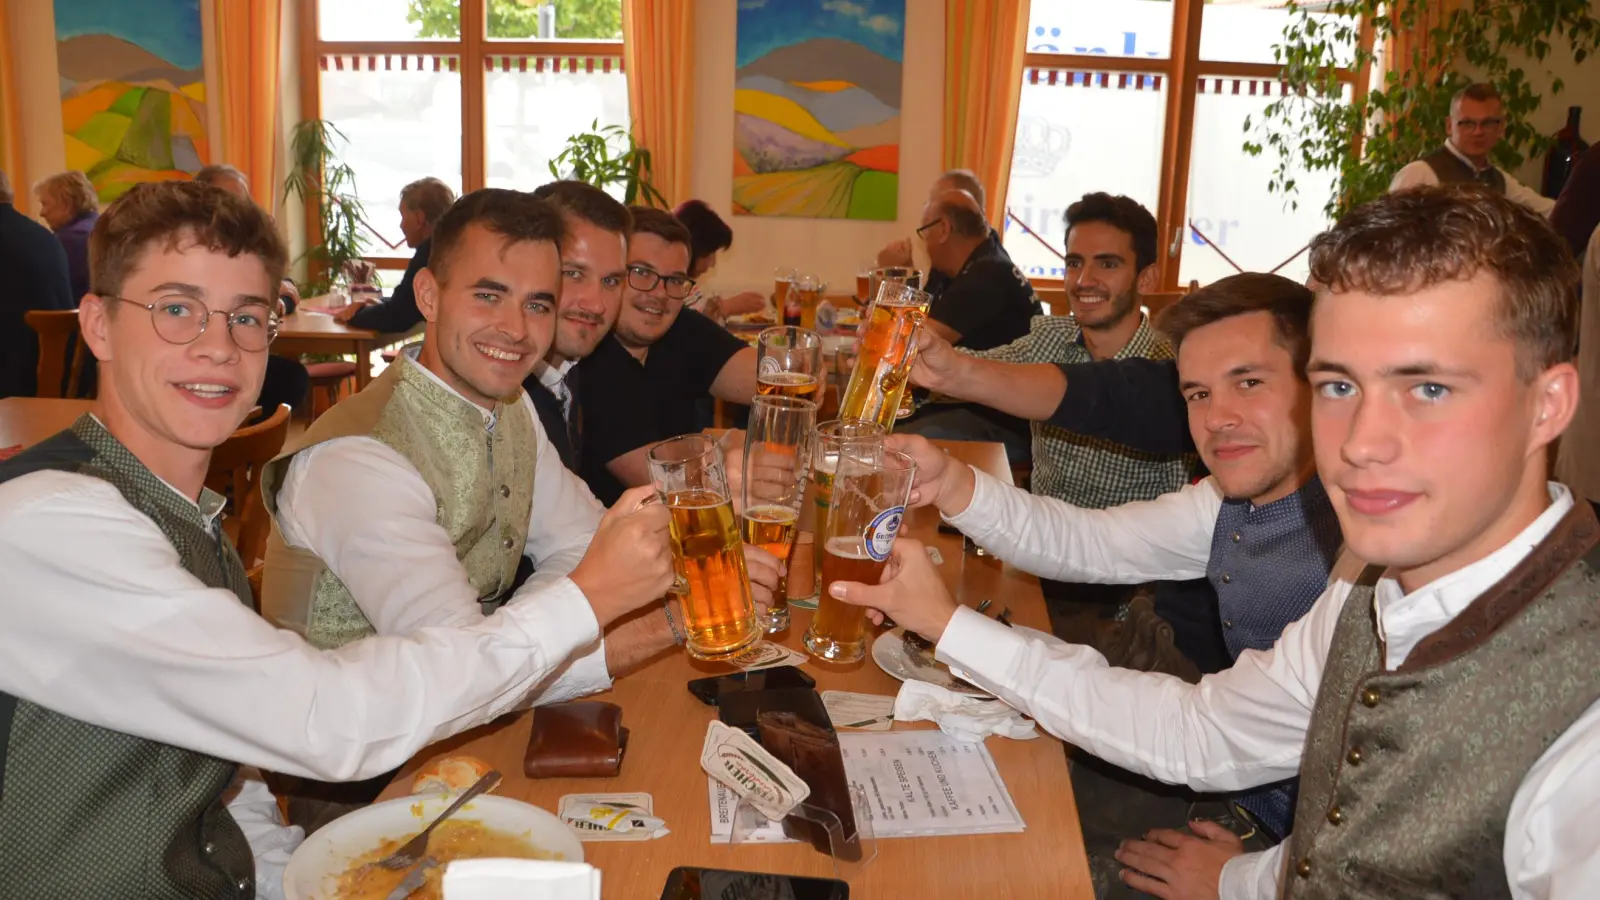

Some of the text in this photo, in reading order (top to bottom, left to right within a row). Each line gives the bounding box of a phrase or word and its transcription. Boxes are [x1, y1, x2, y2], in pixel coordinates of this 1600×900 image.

[892, 759, 909, 783] SPEISEN
[901, 783, 916, 802] KALTE
[942, 786, 960, 811] KAFFEE
